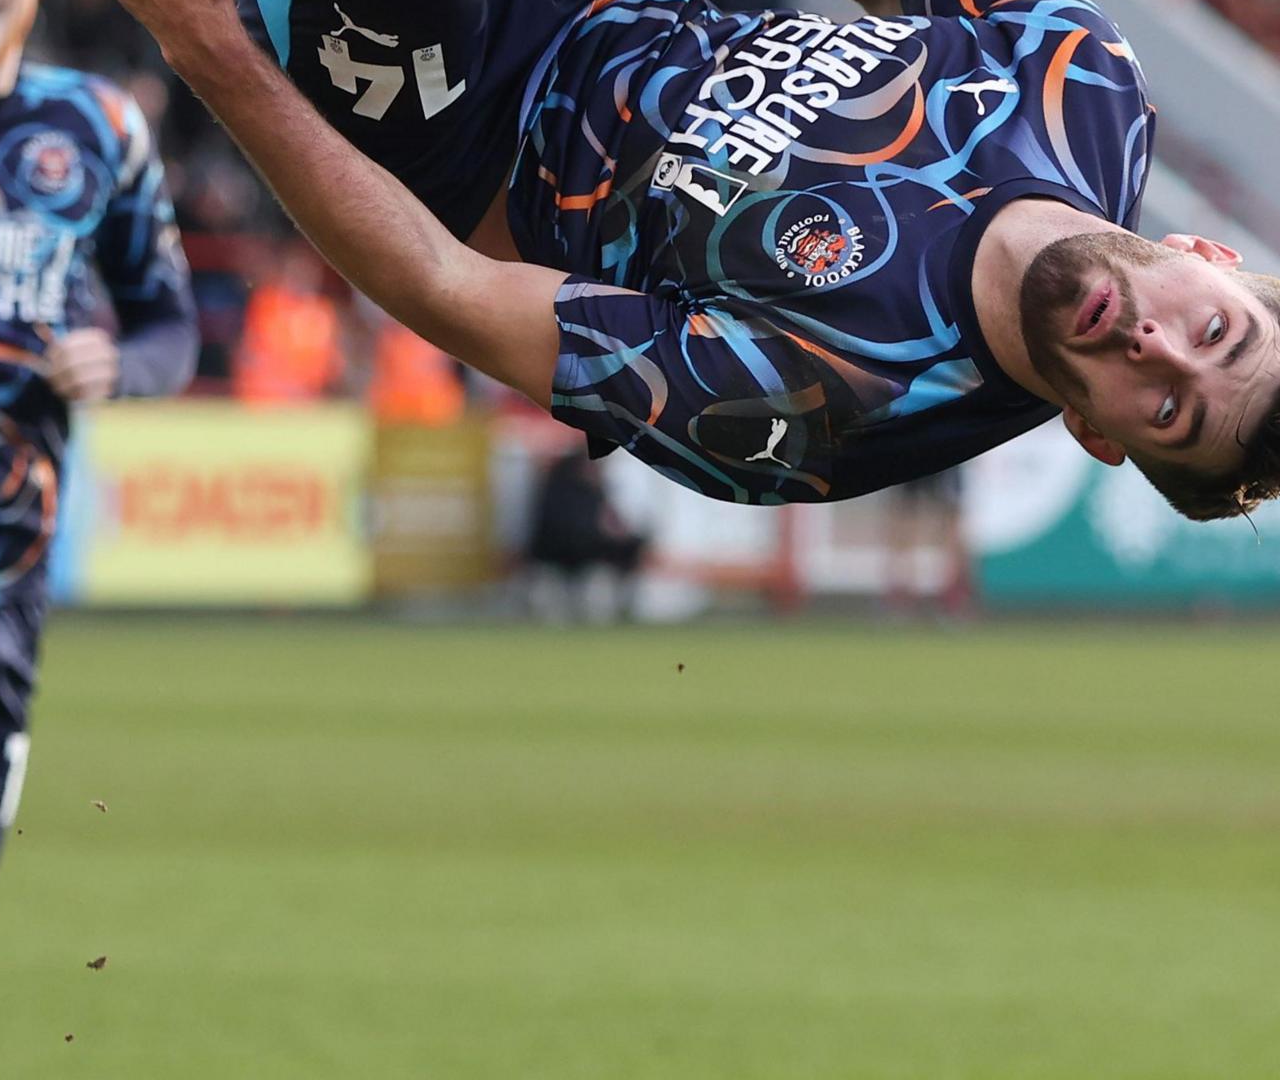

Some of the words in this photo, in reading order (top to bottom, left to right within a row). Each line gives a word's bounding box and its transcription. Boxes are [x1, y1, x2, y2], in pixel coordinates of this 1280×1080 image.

[316, 34, 467, 121] 14
[707, 15, 917, 177] PLEASURE
[775, 247, 789, 270] CLUB
[778, 214, 830, 246] FOOTBALL
[804, 226, 865, 287] BLACKPOOL
